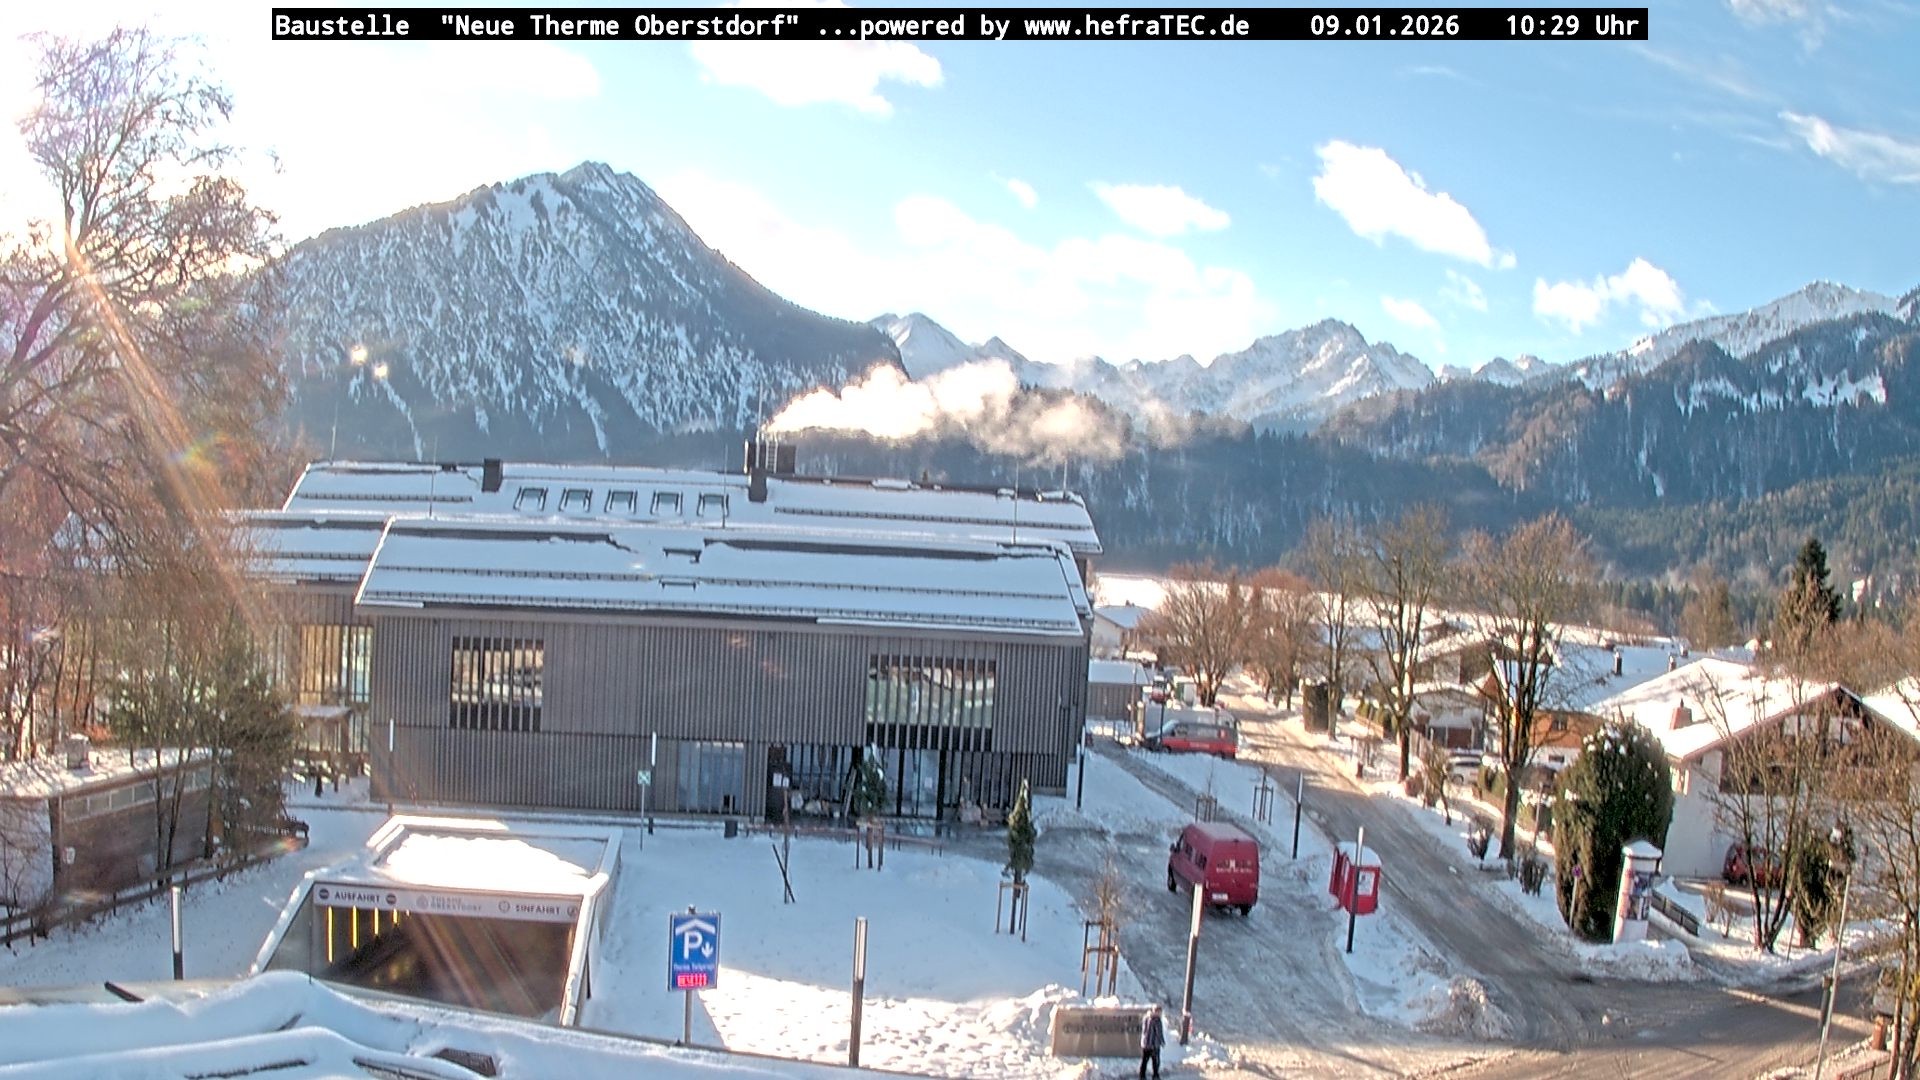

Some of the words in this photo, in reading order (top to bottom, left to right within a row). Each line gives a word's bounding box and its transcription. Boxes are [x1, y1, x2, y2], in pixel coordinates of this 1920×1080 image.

[335, 890, 380, 903] AUSFAHRT
[515, 904, 560, 915] EINFAHRT
[683, 930, 703, 959] P
